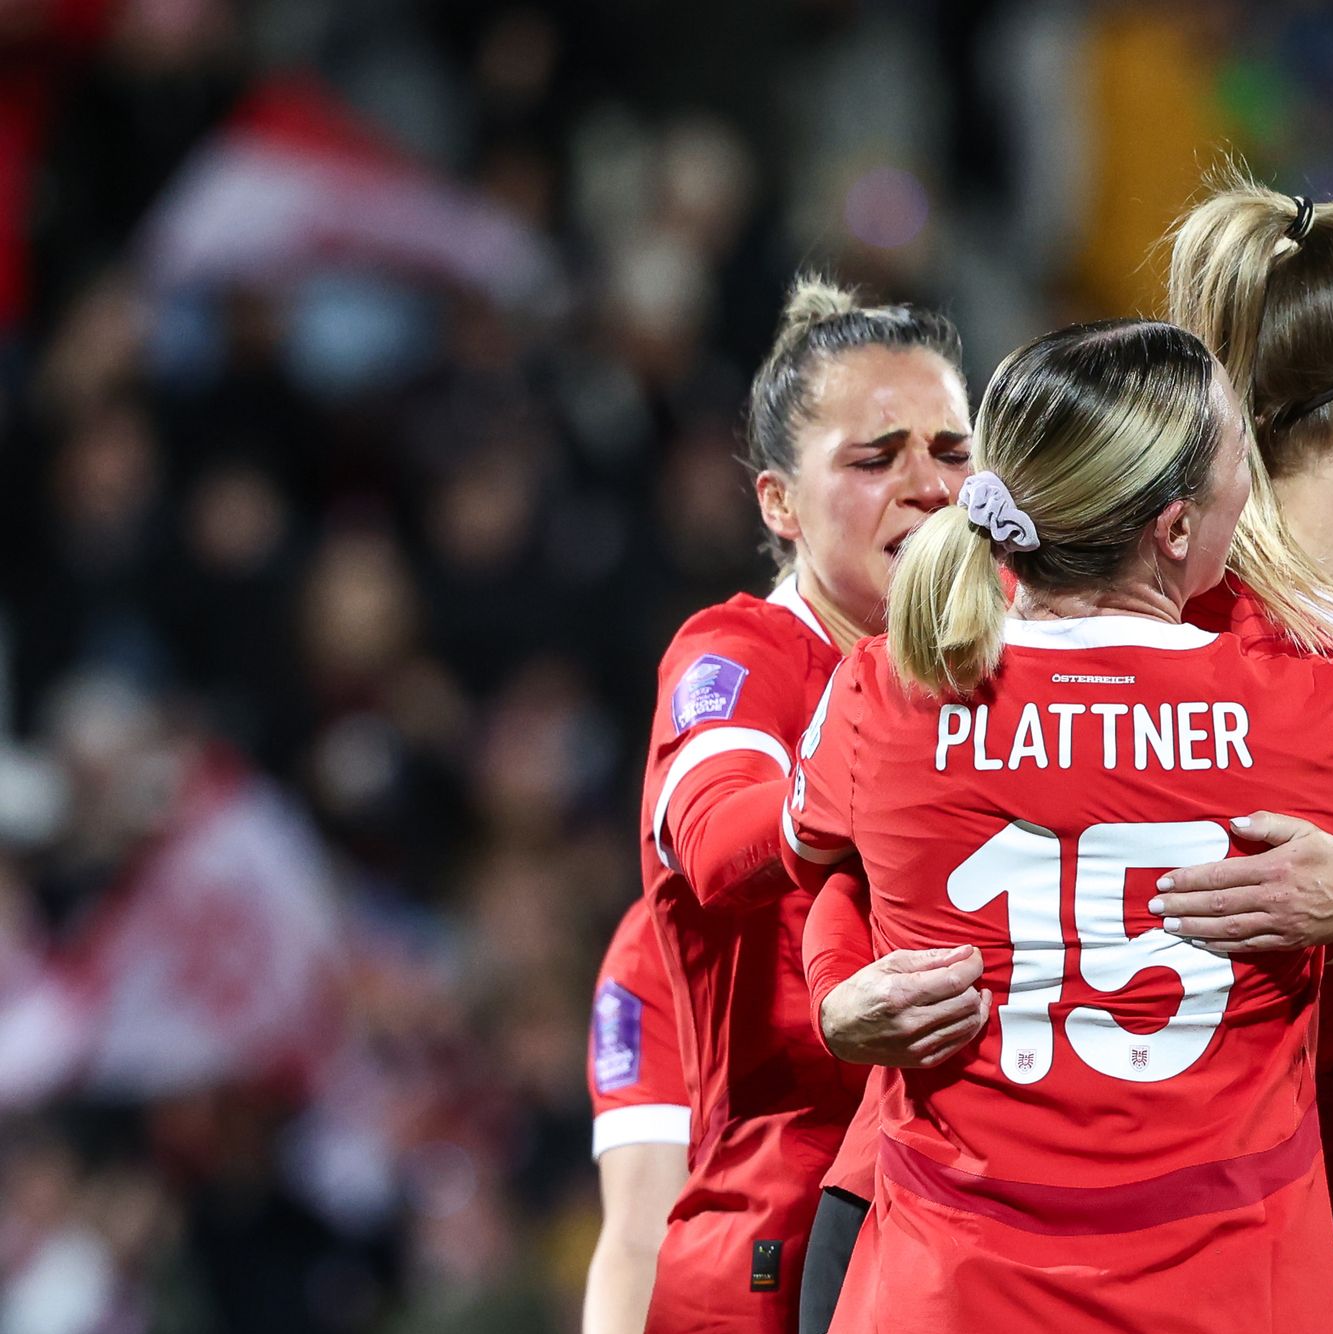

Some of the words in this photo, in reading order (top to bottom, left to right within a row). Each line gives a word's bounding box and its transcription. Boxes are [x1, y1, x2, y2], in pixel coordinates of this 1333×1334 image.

[1051, 673, 1136, 684] ÖSTERREICH
[935, 701, 1254, 772] PLATTNER
[946, 820, 1235, 1085] 15
